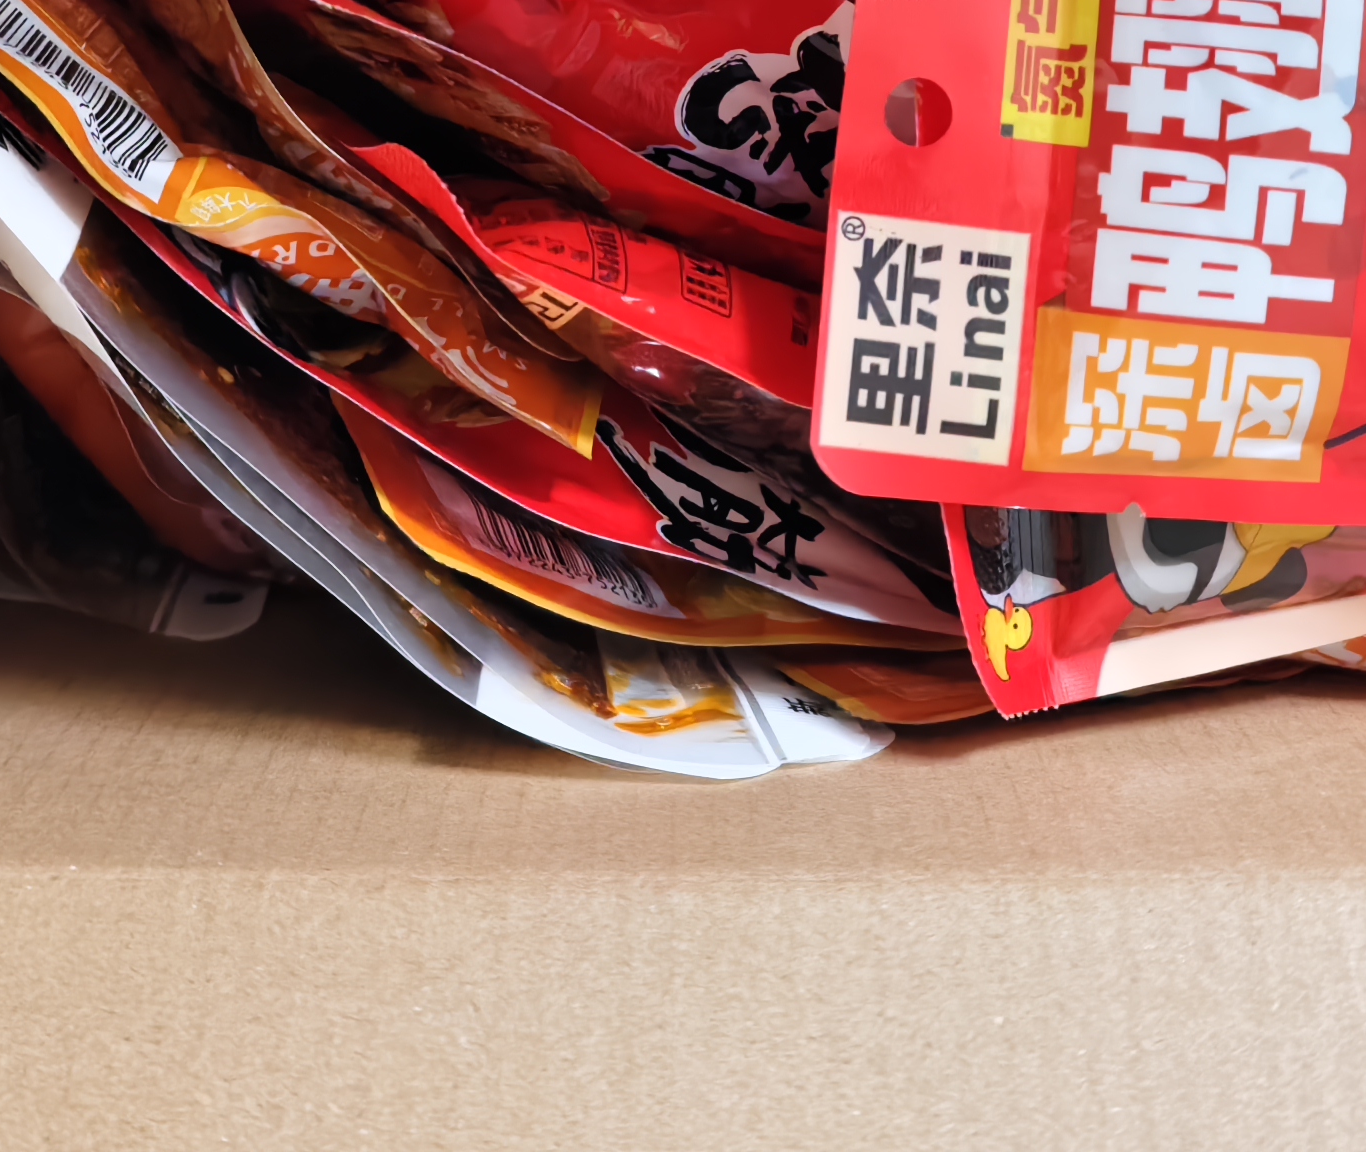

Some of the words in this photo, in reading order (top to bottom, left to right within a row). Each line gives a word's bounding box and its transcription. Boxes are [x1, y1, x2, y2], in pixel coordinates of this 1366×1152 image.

[845, 236, 943, 436] 里奈
[939, 251, 1013, 440] Linai
[1061, 331, 1323, 462] 深卤
